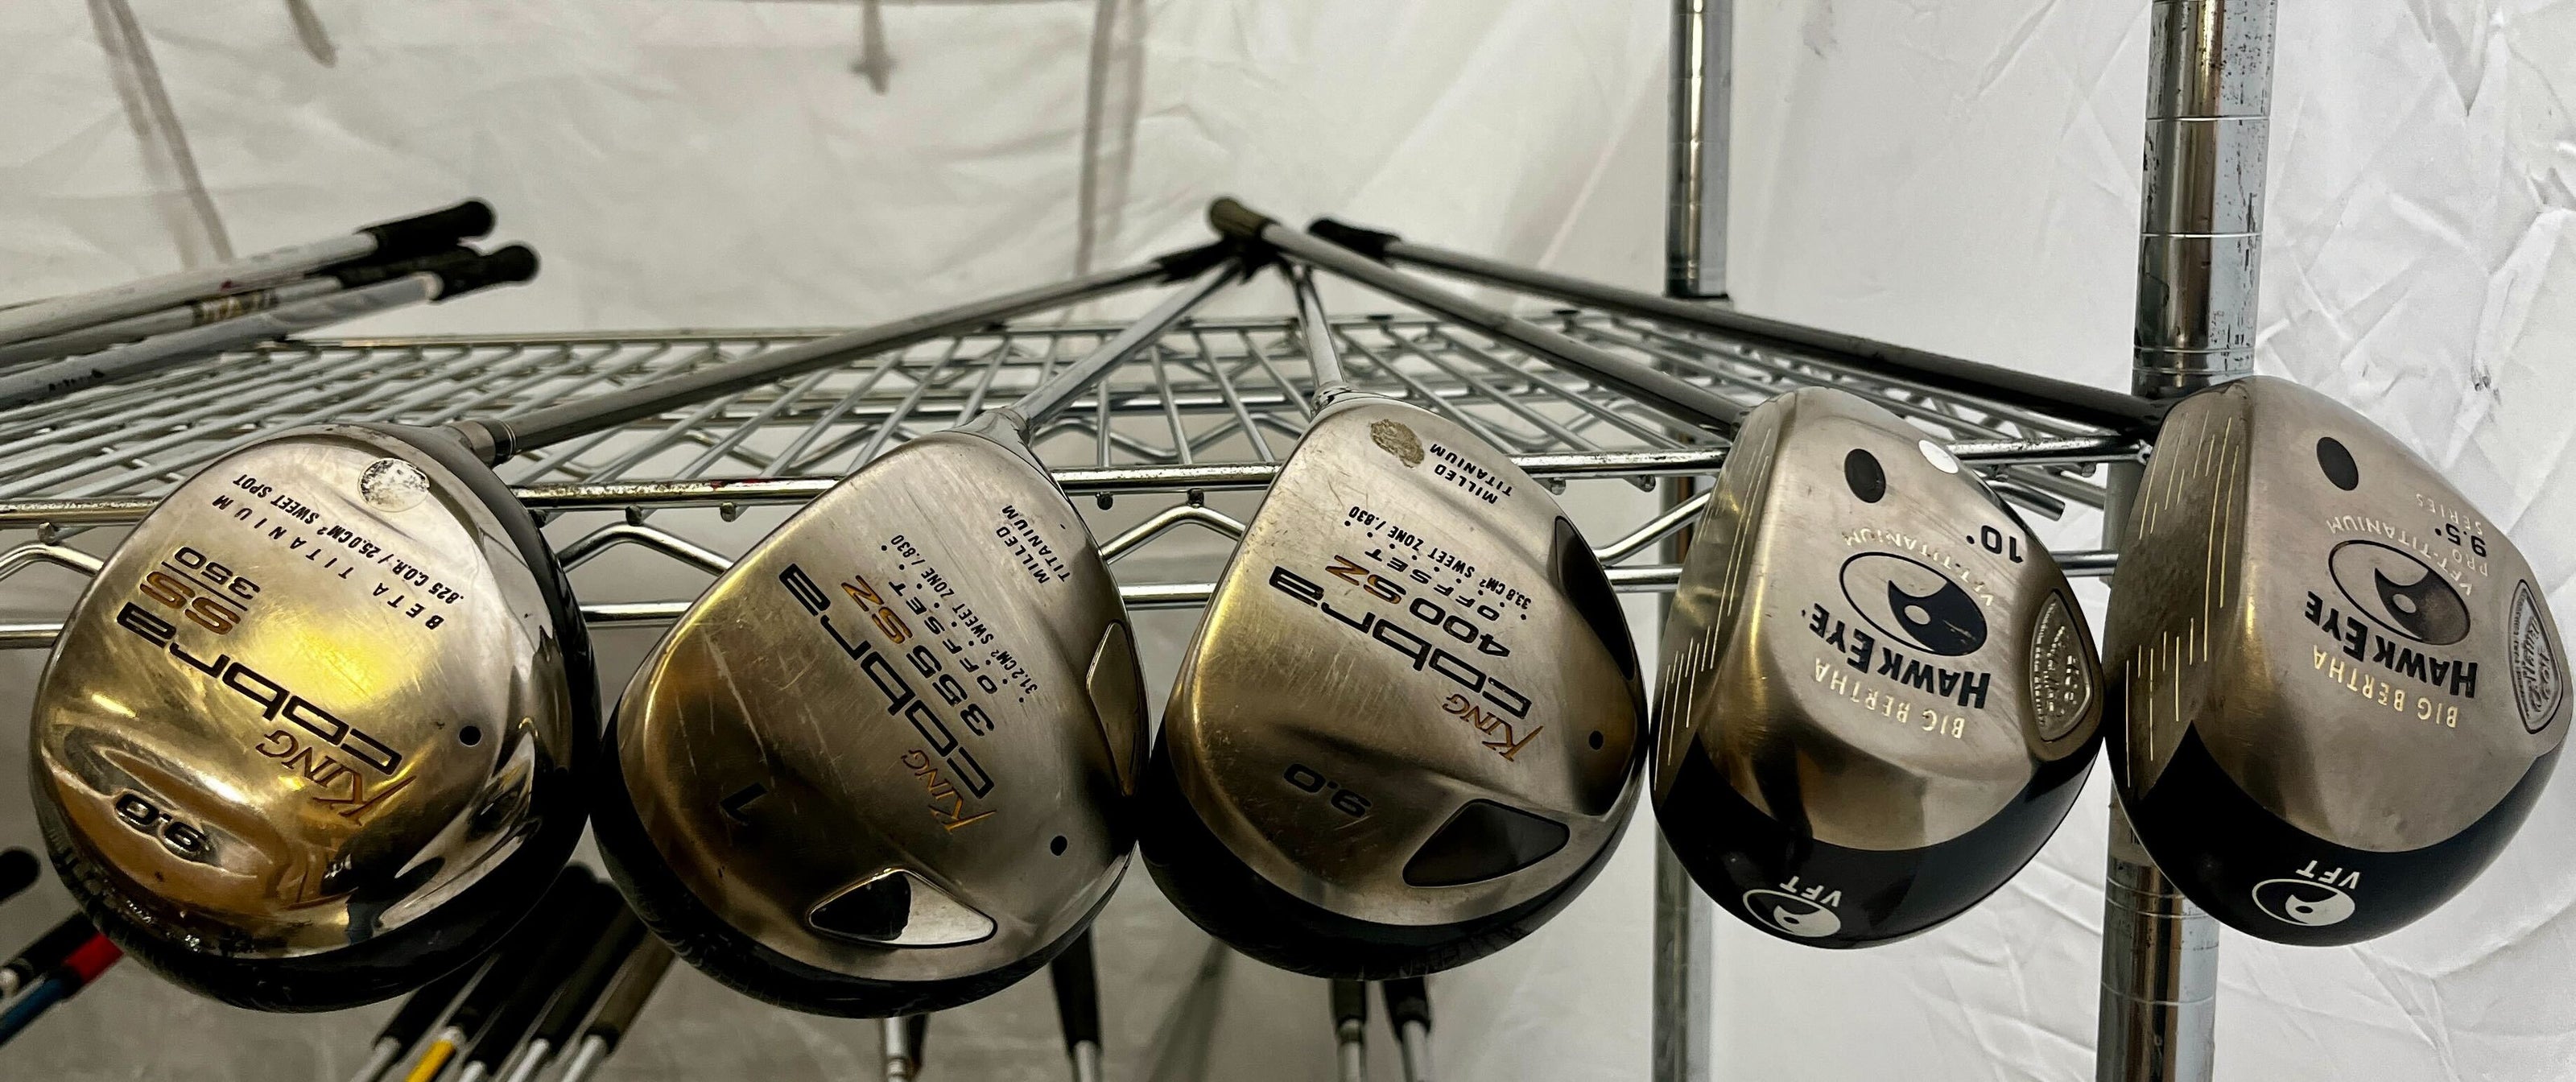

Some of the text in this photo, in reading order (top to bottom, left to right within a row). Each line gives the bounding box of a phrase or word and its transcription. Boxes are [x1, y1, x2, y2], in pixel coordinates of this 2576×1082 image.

[233, 473, 273, 498] SPOT
[1430, 444, 1513, 497] TITANIUM
[1435, 464, 1498, 505] MILLED
[270, 494, 320, 524] SWEET
[2416, 493, 2483, 535] SERIES
[212, 494, 444, 630] BETA TITANIUM
[996, 527, 1051, 584] MILLED
[1002, 505, 1071, 583] TITANIUM
[1387, 526, 1424, 551] ZONE
[1427, 547, 1476, 579] SWEET
[2326, 514, 2474, 596] VFT-TITANIUM
[2452, 549, 2488, 576] PRO
[174, 546, 261, 601] 350
[392, 560, 429, 588] C.O.R.
[428, 582, 464, 605] .825
[921, 567, 955, 599] ZONE
[1364, 549, 1500, 622] OFFSET
[1505, 588, 1532, 609] 33.8
[139, 571, 242, 635] SS
[952, 603, 994, 644] SWEET
[1325, 555, 1510, 657] 400 SZ
[840, 575, 995, 737] 355 SZ
[889, 581, 997, 694] OFFSET
[1269, 565, 1532, 720] cobra
[116, 601, 402, 776] cobra
[778, 564, 995, 799] cobra
[1012, 667, 1038, 694] 31.2
[1814, 658, 1966, 739] BIG BERTHA
[2313, 644, 2458, 728] BIG BERTHA
[1442, 693, 1544, 762] KING
[255, 729, 416, 826] KING
[901, 750, 997, 833] KING
[1283, 763, 1372, 818] 9.0
[114, 791, 208, 856] 9.0
[1779, 875, 1842, 907] VFT
[2296, 860, 2360, 890] VFT
